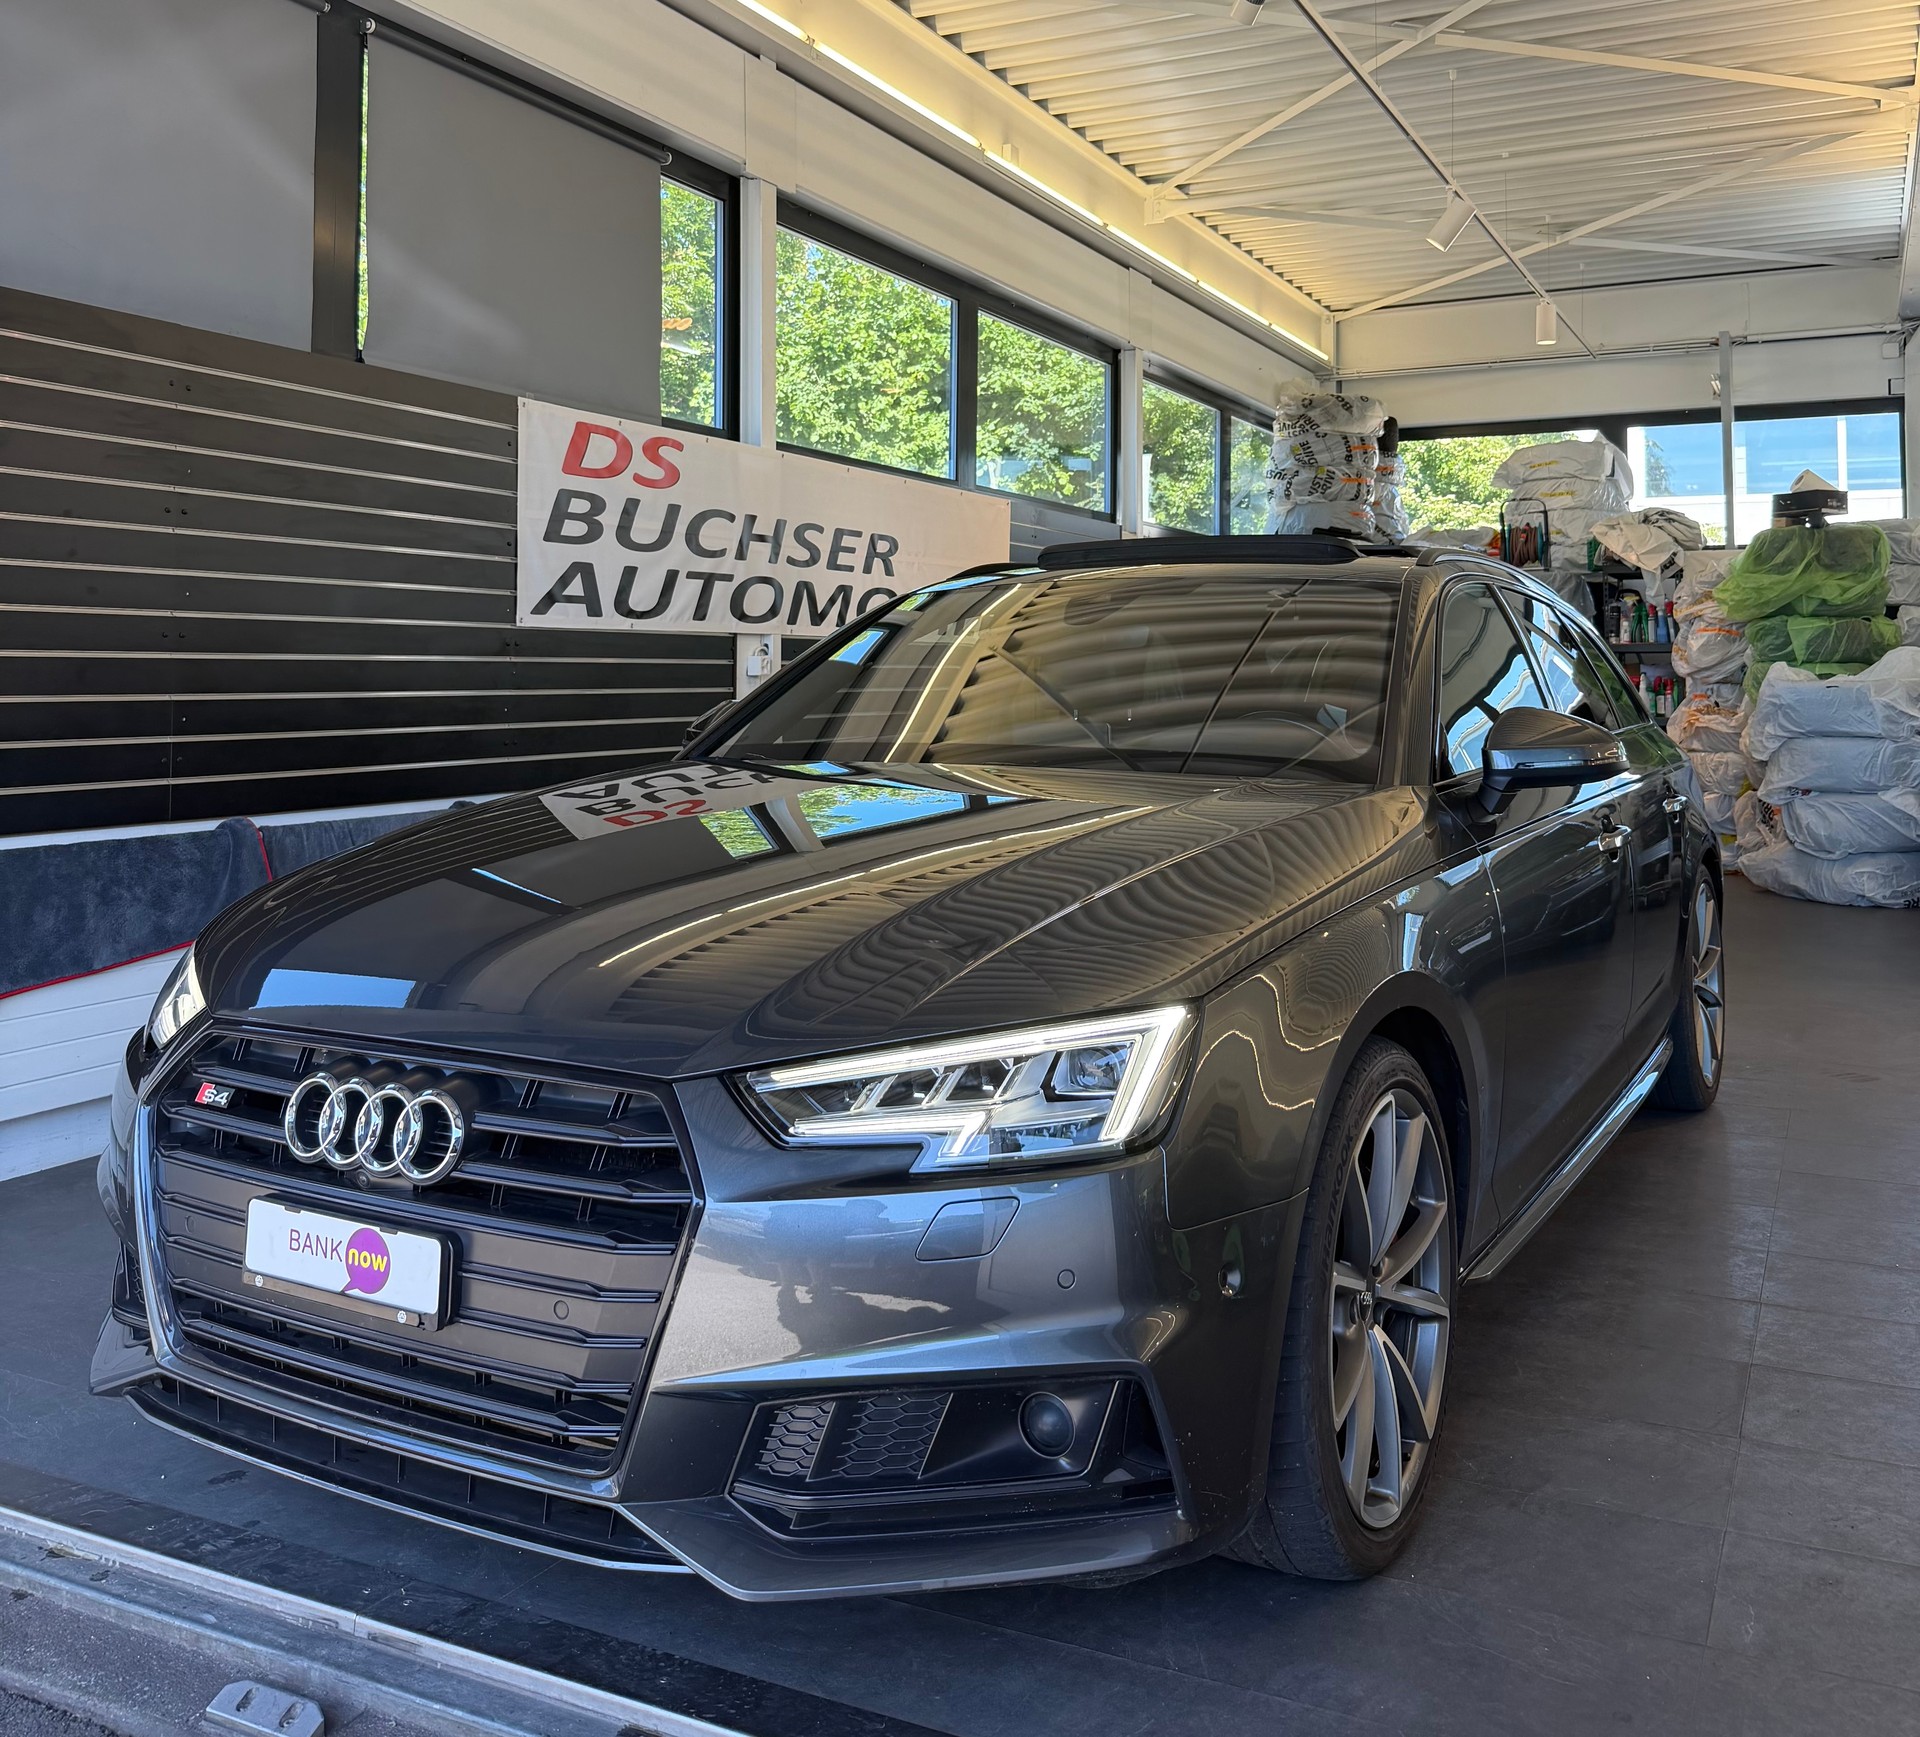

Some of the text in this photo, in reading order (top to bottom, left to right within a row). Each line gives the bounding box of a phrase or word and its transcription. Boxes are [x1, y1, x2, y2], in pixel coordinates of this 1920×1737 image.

[561, 421, 684, 490] DS
[542, 488, 899, 577] BUCHSER
[202, 1088, 230, 1106] S4
[289, 1228, 388, 1273] BANK now
